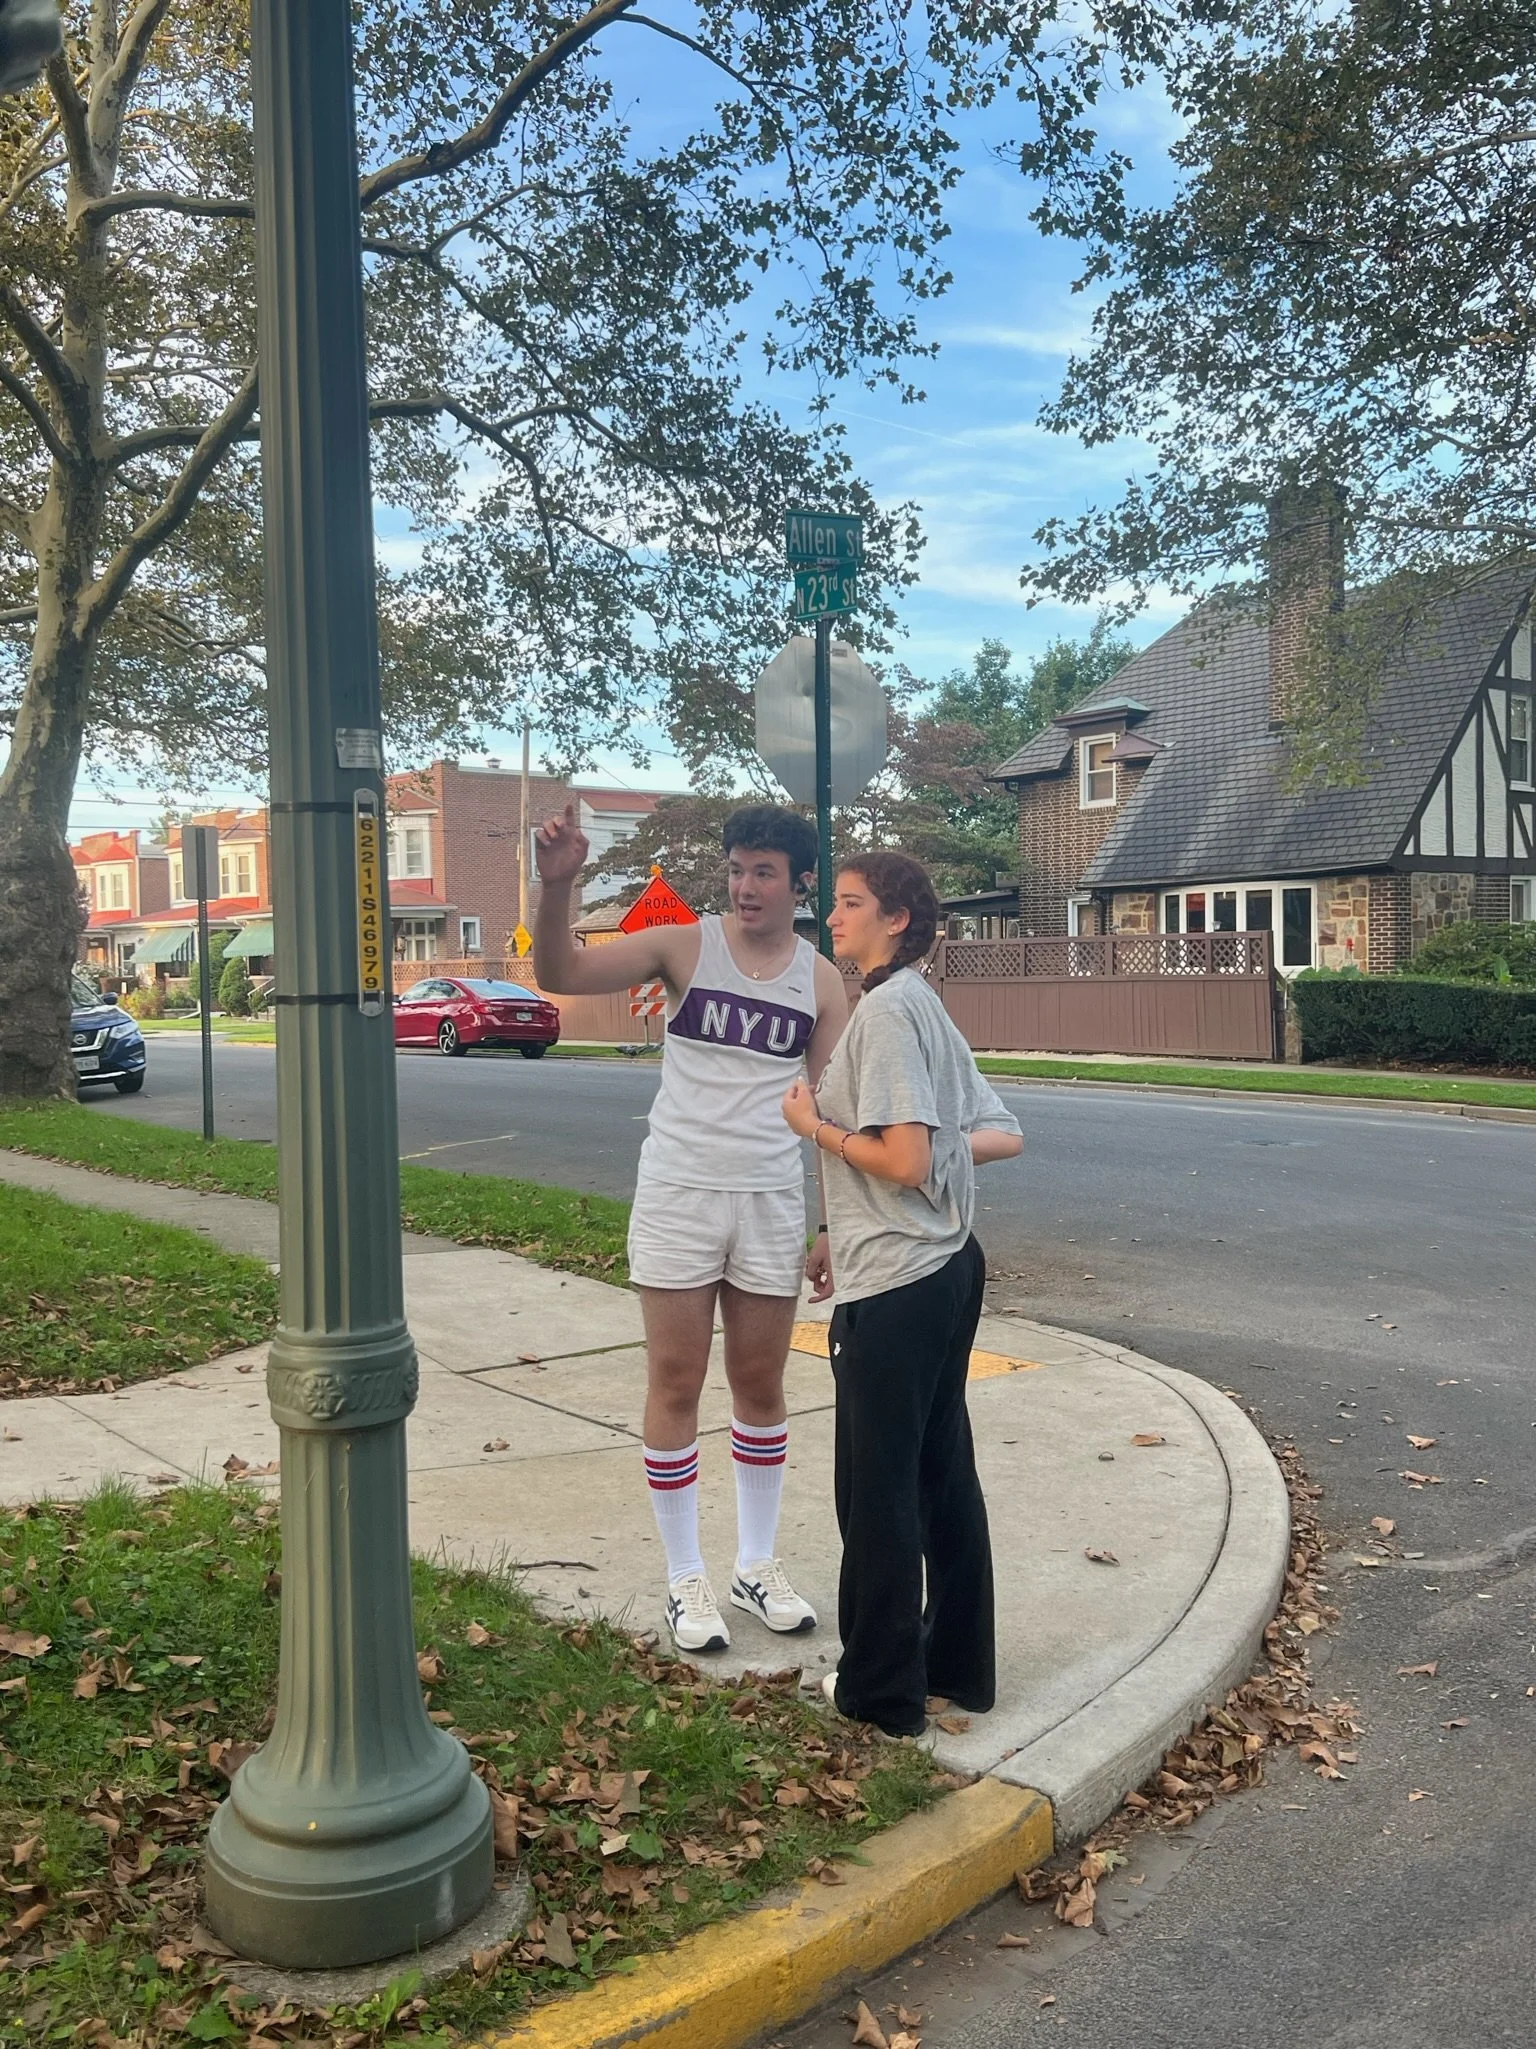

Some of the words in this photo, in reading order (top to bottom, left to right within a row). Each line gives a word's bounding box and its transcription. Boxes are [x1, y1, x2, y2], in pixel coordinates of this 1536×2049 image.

[789, 516, 837, 556] Allen
[847, 528, 862, 557] St
[797, 588, 805, 614] N
[808, 572, 838, 611] 23rd
[842, 577, 856, 607] St
[645, 897, 678, 910] ROAD
[645, 915, 679, 928] WORK
[701, 1000, 797, 1053] NYU
